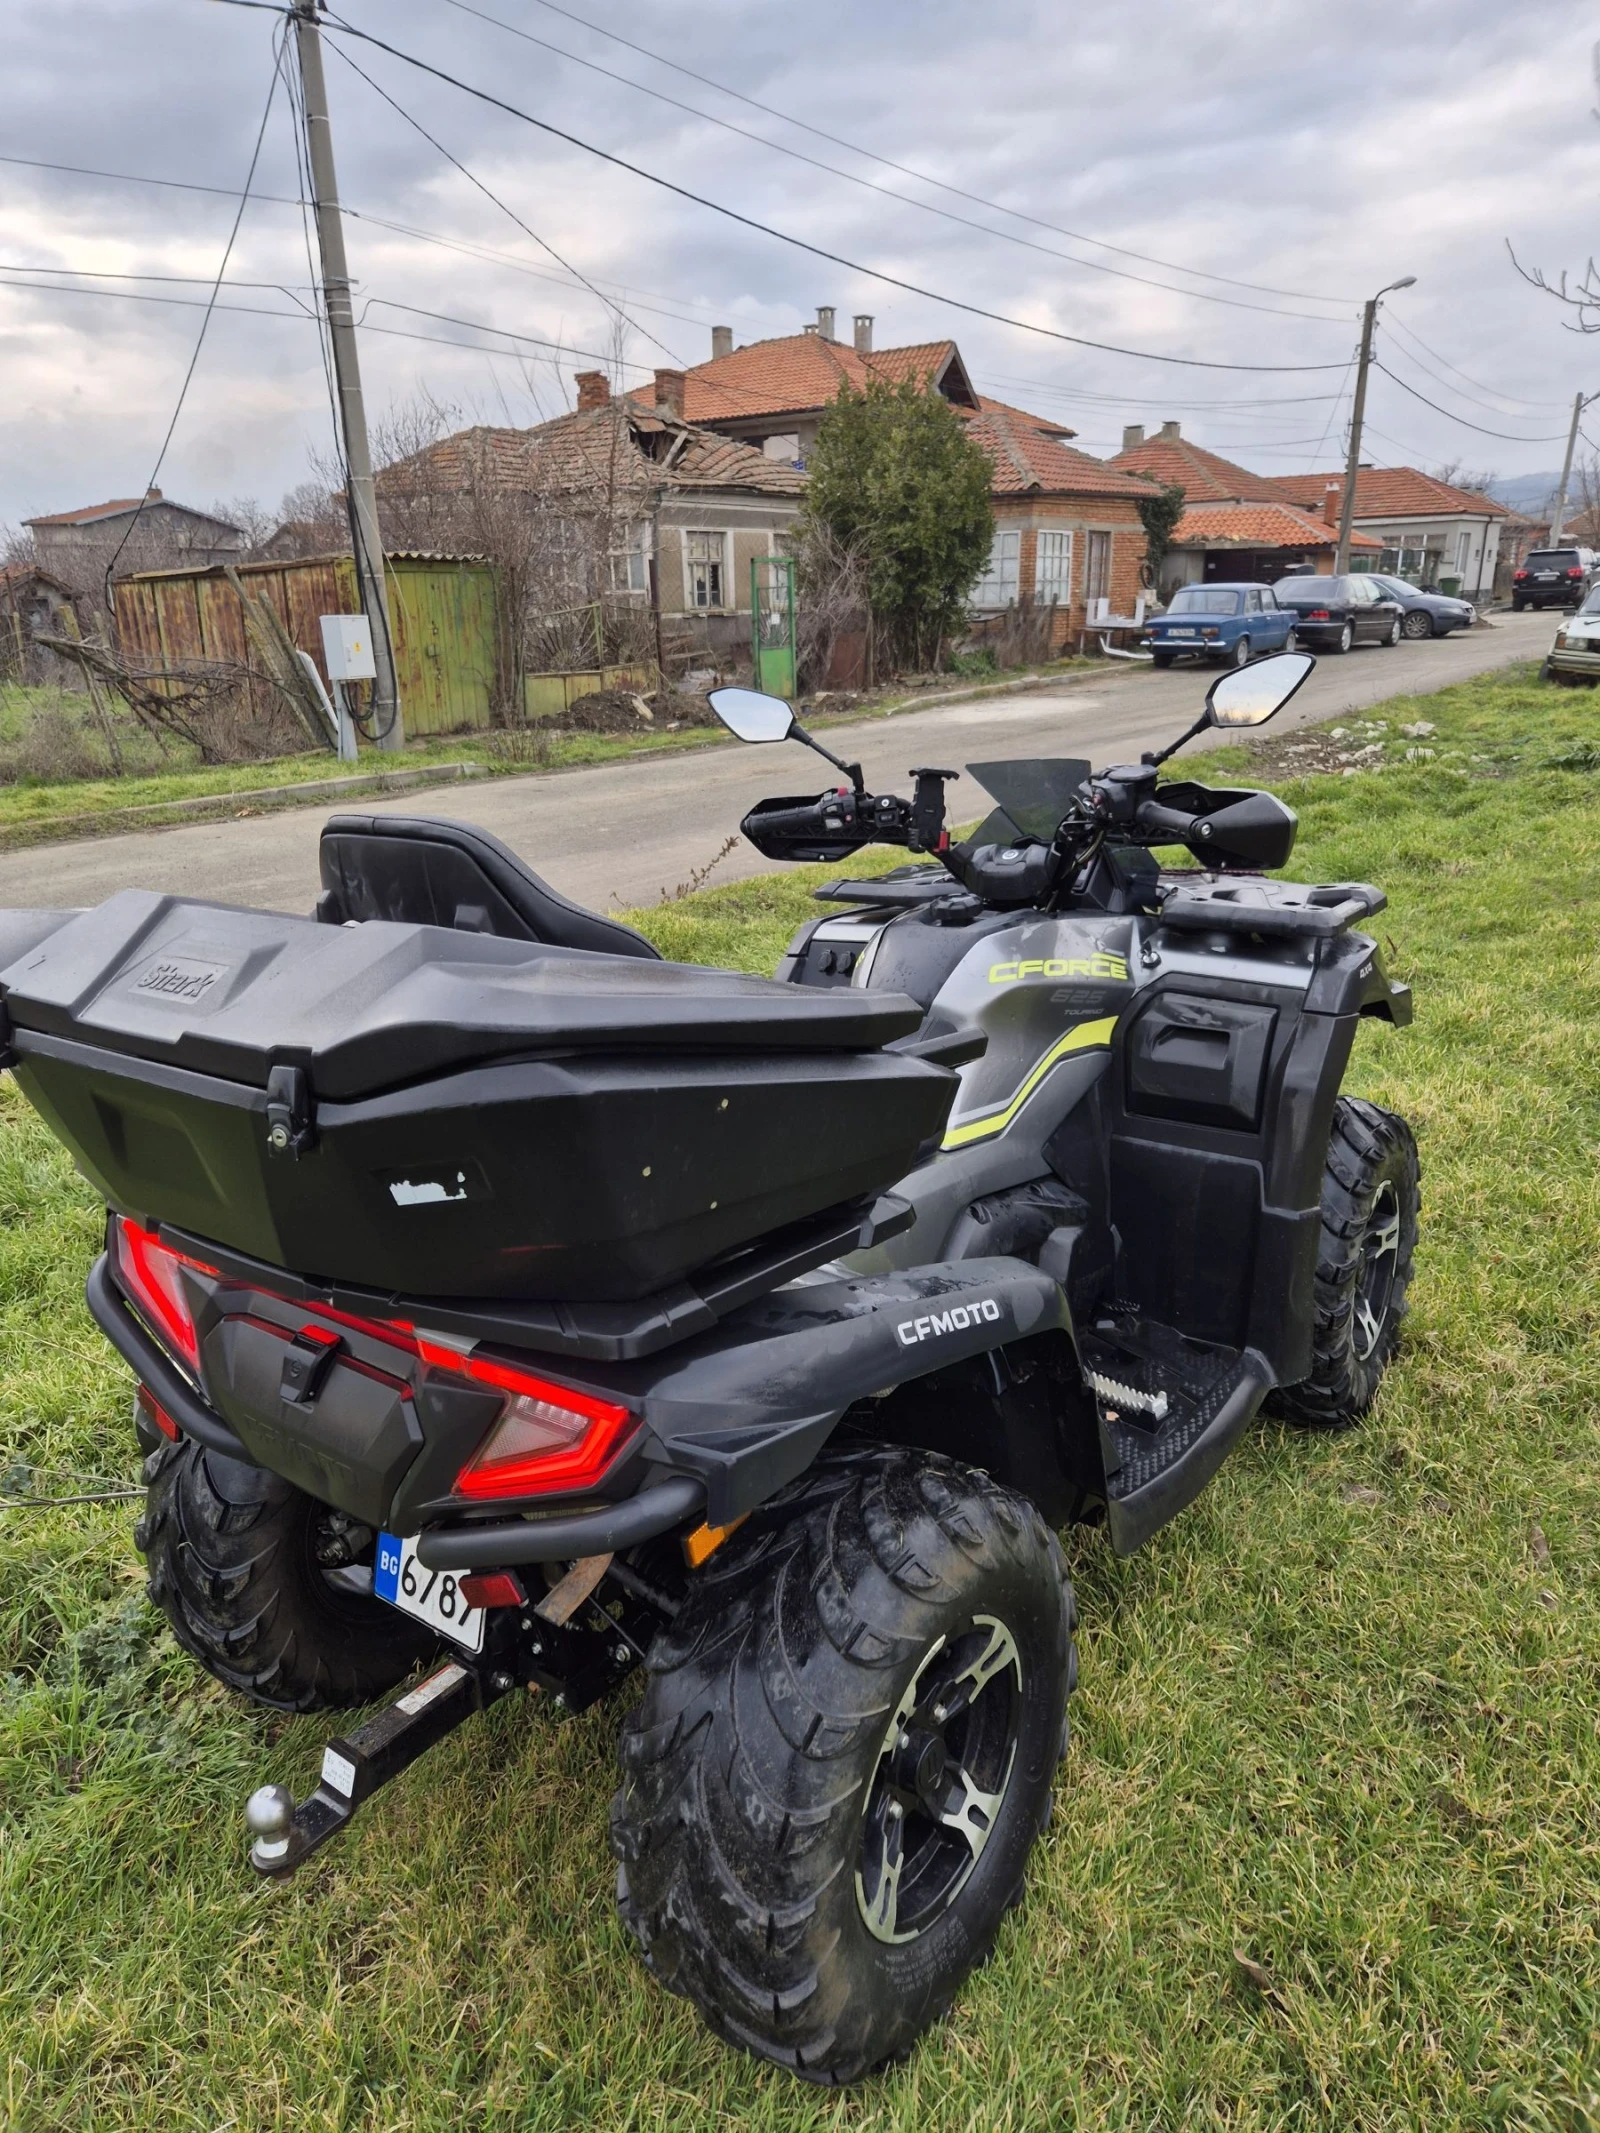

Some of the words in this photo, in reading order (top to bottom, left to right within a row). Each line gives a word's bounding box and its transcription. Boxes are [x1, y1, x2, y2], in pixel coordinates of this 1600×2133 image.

[138, 964, 214, 997] Shark
[988, 952, 1127, 983] CFORCE
[1050, 988, 1107, 1004] 625
[897, 1299, 999, 1345] CFMOTO
[381, 1550, 398, 1575] BG
